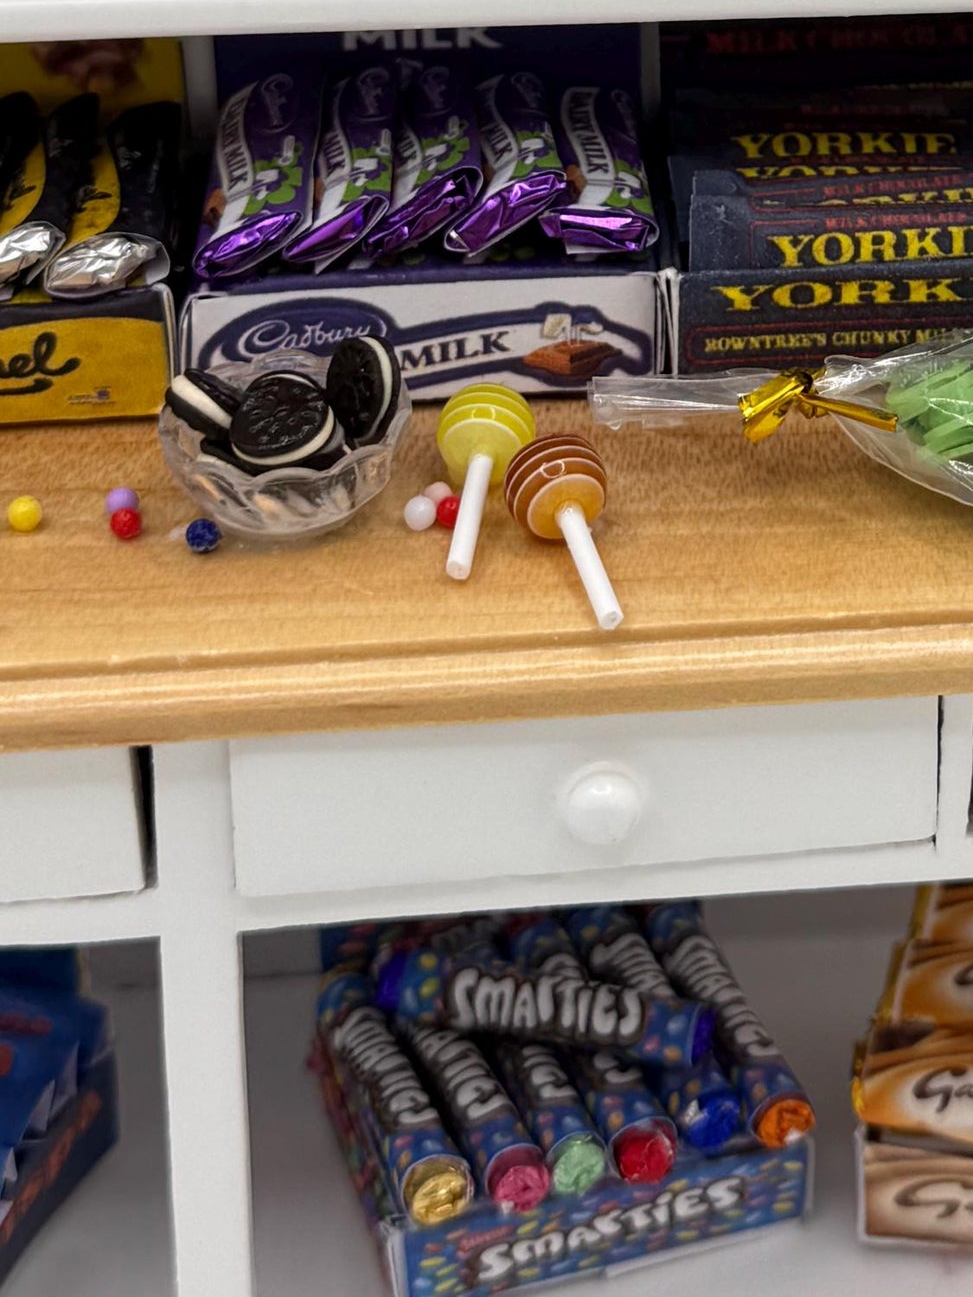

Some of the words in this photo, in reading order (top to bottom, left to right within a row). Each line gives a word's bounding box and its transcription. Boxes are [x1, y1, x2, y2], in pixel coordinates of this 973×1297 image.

[236, 316, 372, 354] Cadbury
[400, 329, 511, 372] MILK
[832, 328, 912, 347] CHUNKY
